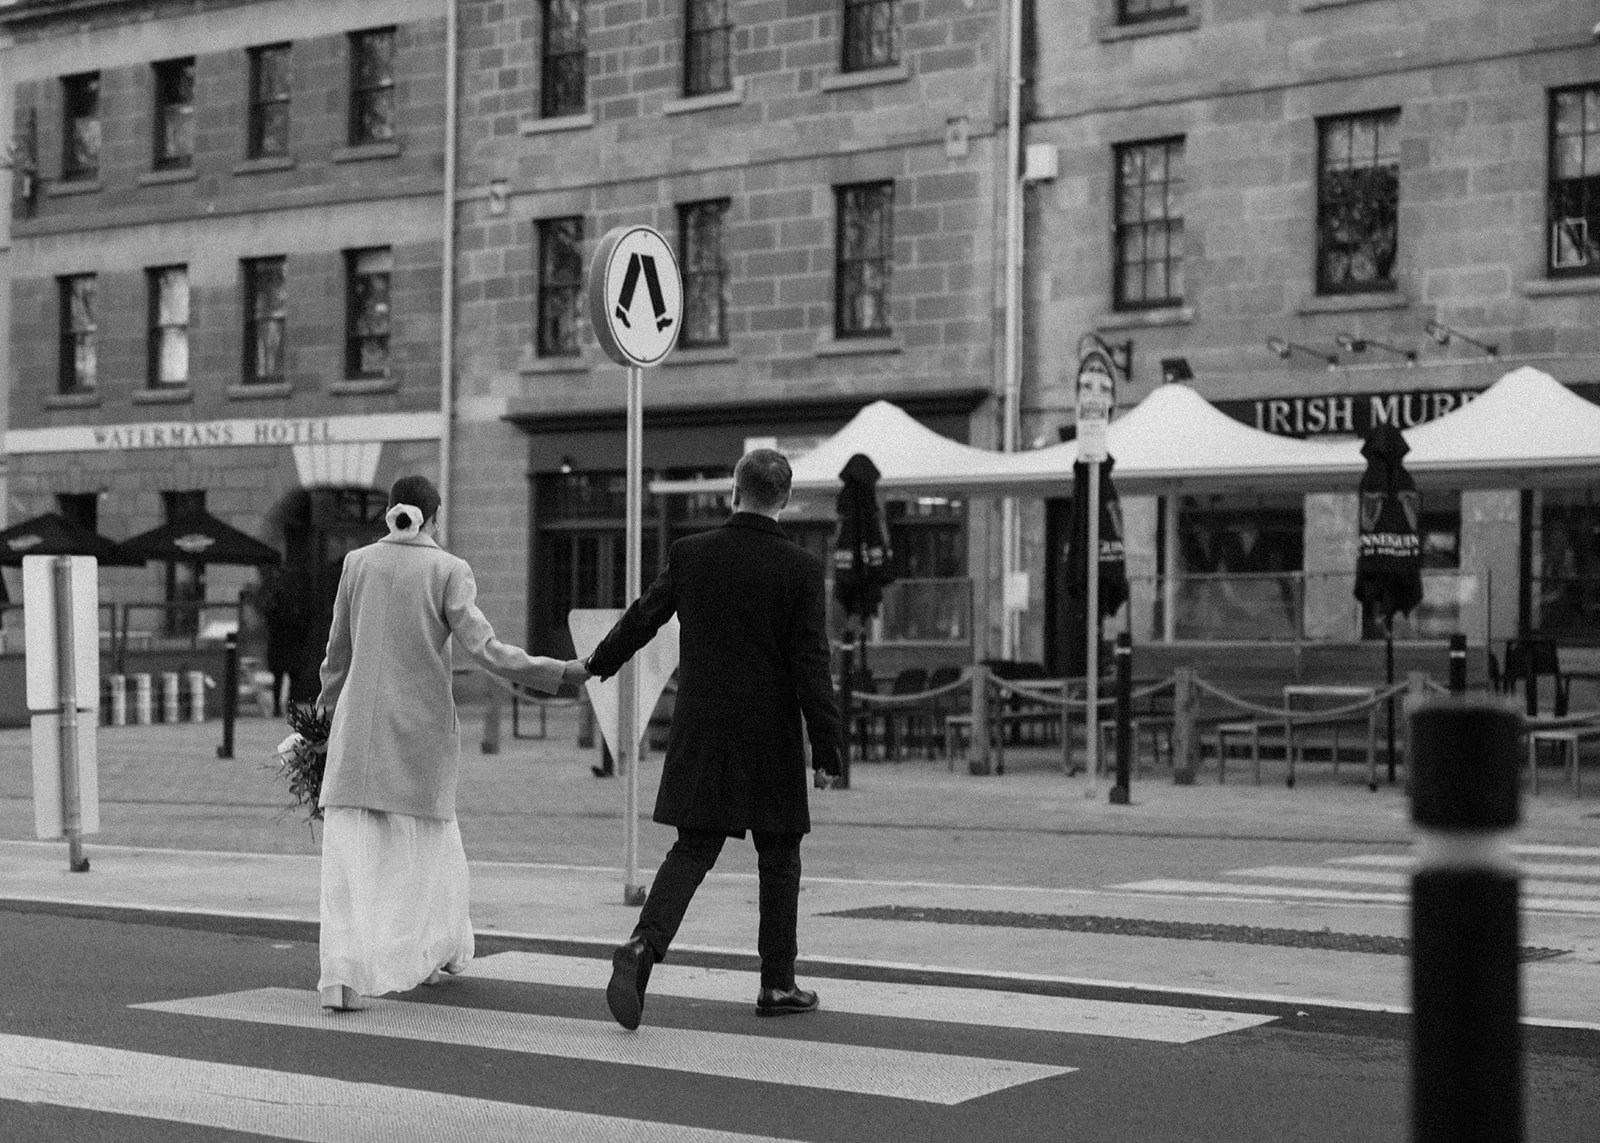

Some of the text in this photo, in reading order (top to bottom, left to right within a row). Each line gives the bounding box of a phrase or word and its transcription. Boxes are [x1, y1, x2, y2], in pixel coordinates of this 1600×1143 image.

[1255, 397, 1353, 432] IRISH
[94, 421, 335, 448] WATERMANS HOTEL
